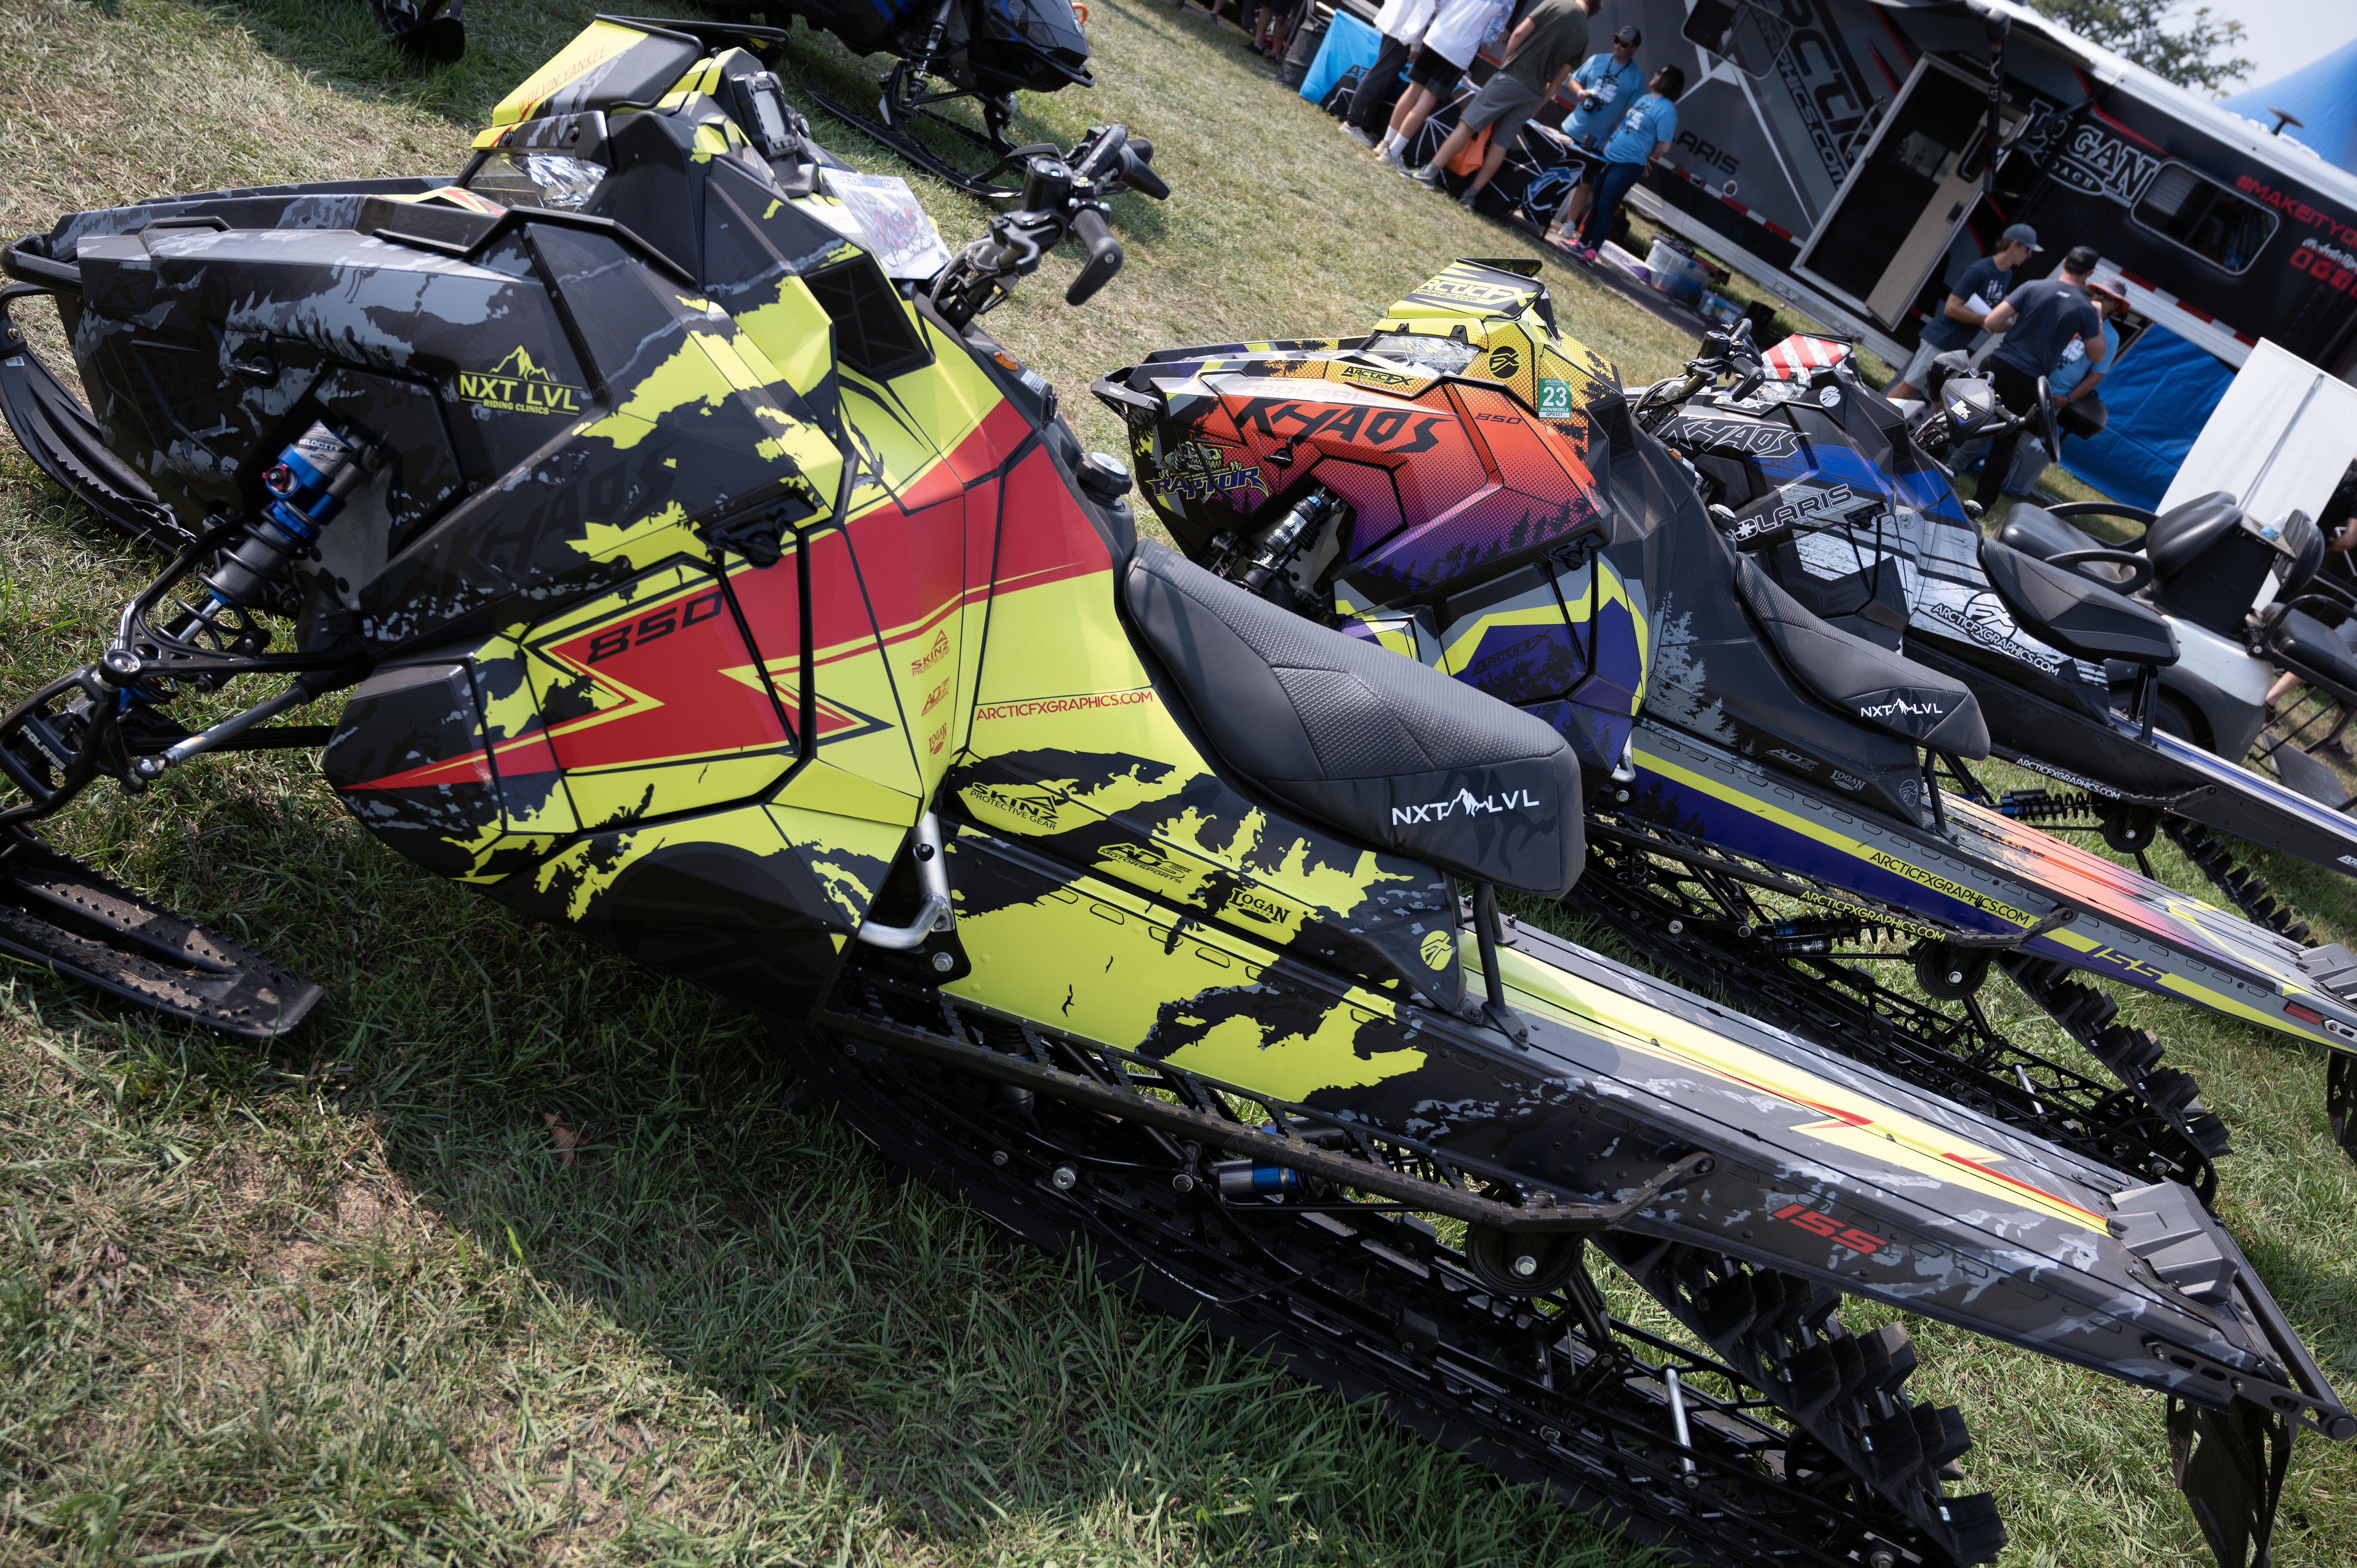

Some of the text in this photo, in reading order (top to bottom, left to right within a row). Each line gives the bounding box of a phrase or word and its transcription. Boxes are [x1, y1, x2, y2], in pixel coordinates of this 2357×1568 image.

[1673, 130, 1740, 176] ARIS
[1415, 289, 1477, 303] GRAPHICS.COM
[460, 374, 580, 410] NXT LVL
[1340, 366, 1416, 386] ARCTICFX
[483, 399, 550, 415] RIDING CLINICS
[1543, 386, 1567, 407] 23
[1233, 397, 1454, 453] KHAOS
[1475, 413, 1522, 425] 850
[1655, 416, 1812, 458] KHAOS
[1147, 466, 1269, 500] RAPTOR
[586, 591, 724, 665] 850
[1932, 603, 2060, 676] ARCTICFXGRAPHICS.COM
[911, 640, 950, 671] SKINZ
[912, 648, 950, 676] PROTECTIVE GEAR
[1472, 628, 1552, 677] ARCTICFX
[976, 691, 1153, 721] ARCTICFXGRAPHICS.COM
[1861, 703, 1943, 717] NXT LVL
[20, 725, 67, 770] POLARIS
[929, 722, 947, 753] LOGAN
[1765, 751, 1812, 771] MOTORSPORTS
[1830, 770, 1867, 791] LOGAN
[2016, 758, 2121, 800] ARCTICFXGRAPHICS.COM
[970, 790, 1057, 830] PROTECTIVE GEAR
[972, 782, 1059, 824] SKINZ
[1392, 789, 1539, 825] NXT LVL
[1100, 849, 1183, 883] MOTORSPORTS
[1104, 843, 1185, 879] ADS
[1229, 889, 1290, 924] LOGAN
[1869, 852, 2031, 926] ARCTICFXGRAPHICS.COM
[1245, 904, 1271, 917] COACH
[1799, 890, 1946, 942] ARCTICFXGRAPHICS.COM
[1772, 1203, 1888, 1254] 155
